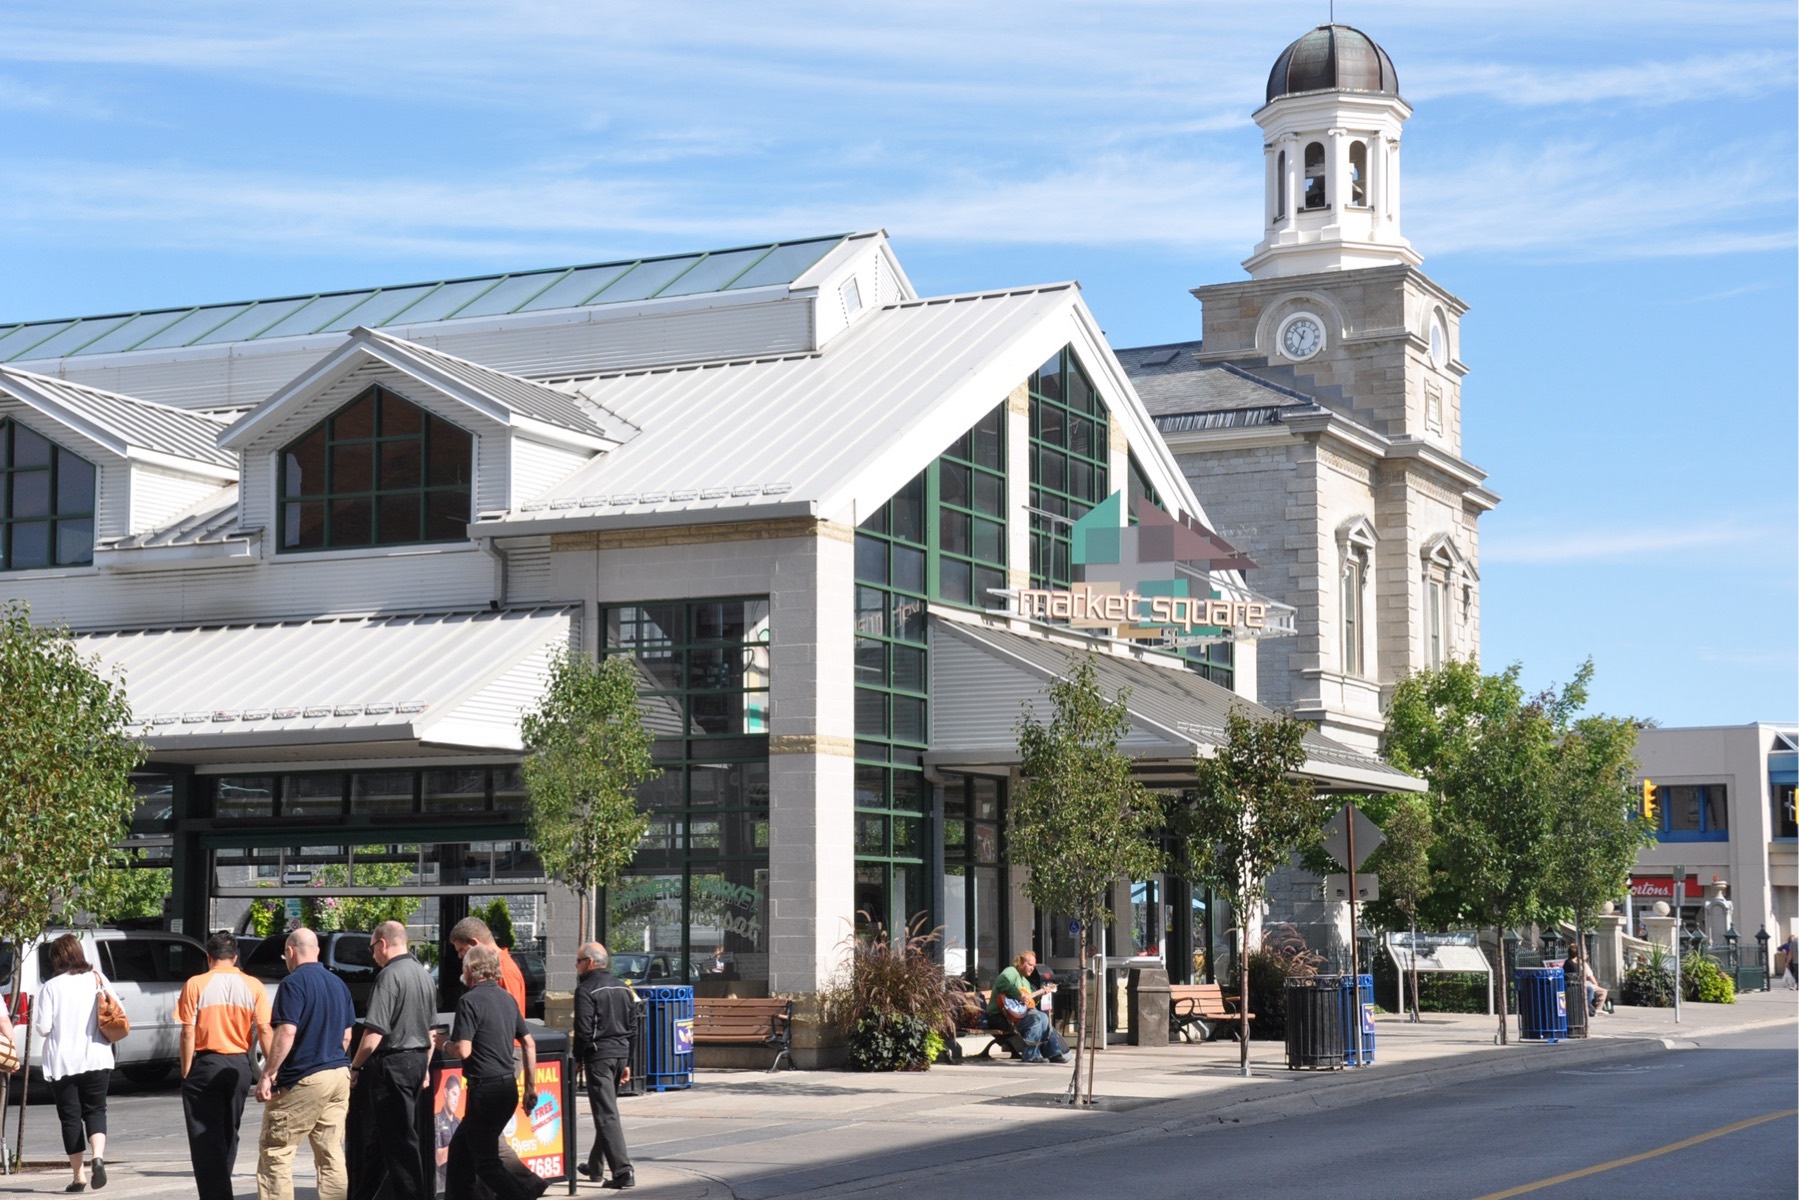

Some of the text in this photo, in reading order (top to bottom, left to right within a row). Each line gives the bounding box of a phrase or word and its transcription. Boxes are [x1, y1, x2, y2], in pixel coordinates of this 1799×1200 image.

[1018, 586, 1266, 633] market square
[534, 1100, 554, 1120] FREE
